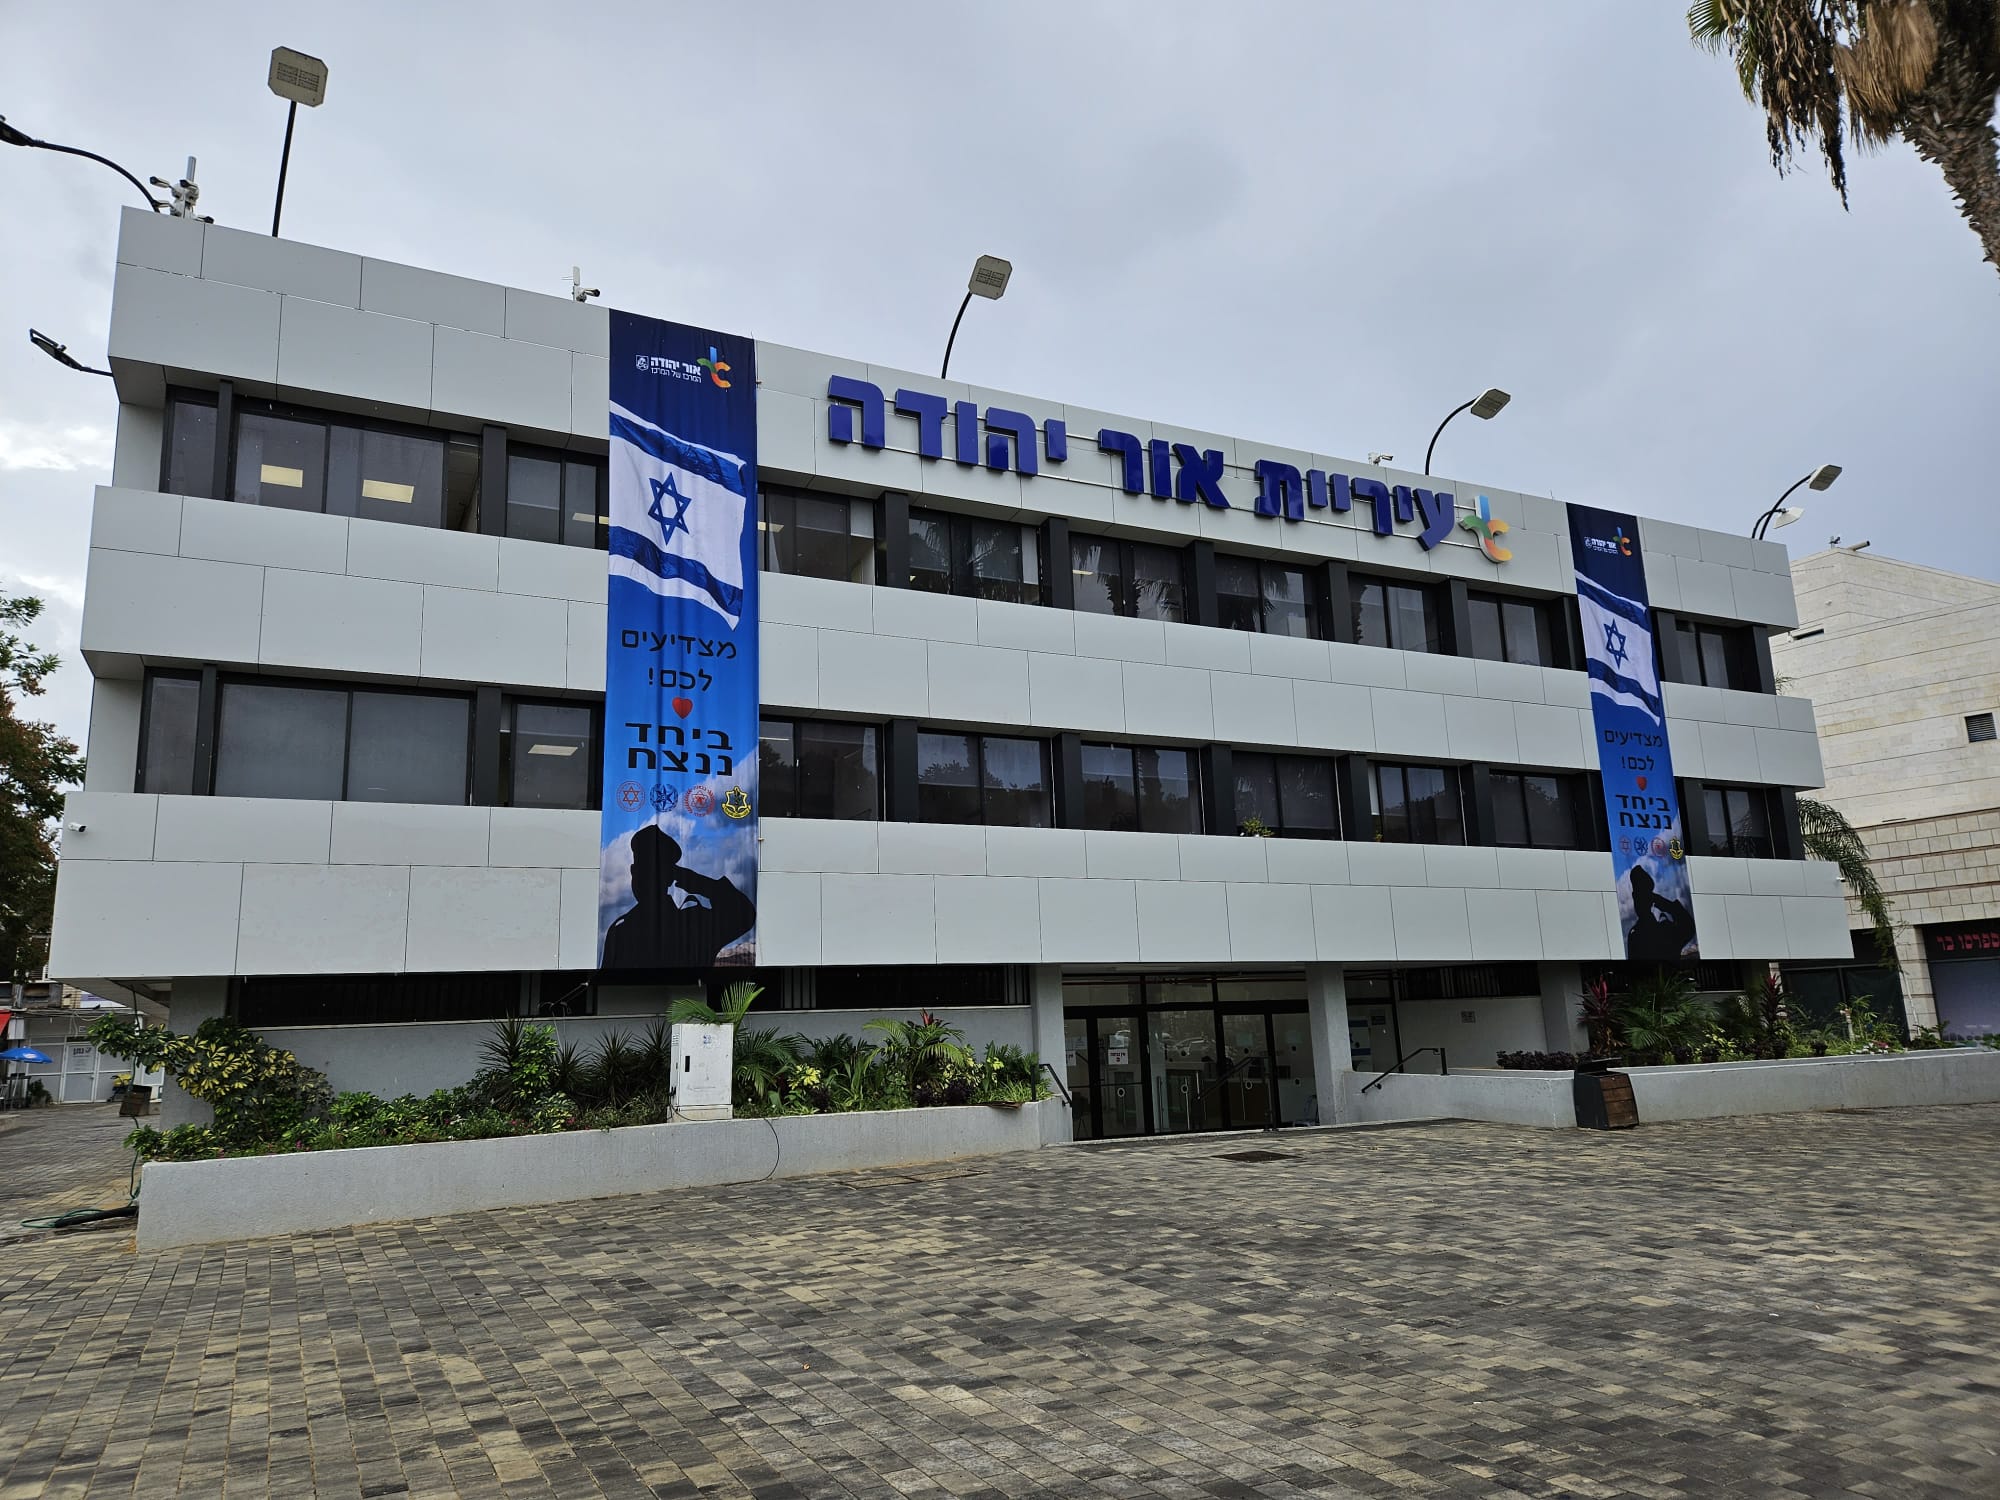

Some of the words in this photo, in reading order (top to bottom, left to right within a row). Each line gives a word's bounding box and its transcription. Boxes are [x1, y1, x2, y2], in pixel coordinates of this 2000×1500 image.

[650, 357, 680, 369] יהודה
[682, 363, 701, 376] אור
[827, 374, 1068, 477] יהודה
[1098, 428, 1231, 509] אור
[1254, 459, 1455, 551] עיריית
[621, 629, 737, 659] מצדיעים
[648, 668, 713, 691] לכם!
[625, 723, 733, 750] ביחד
[1604, 730, 1663, 747] מצדיעים
[628, 748, 732, 776] ננצח
[1621, 755, 1654, 771] לכם!
[1615, 794, 1670, 811] ביחד
[1619, 812, 1672, 829] ננצח
